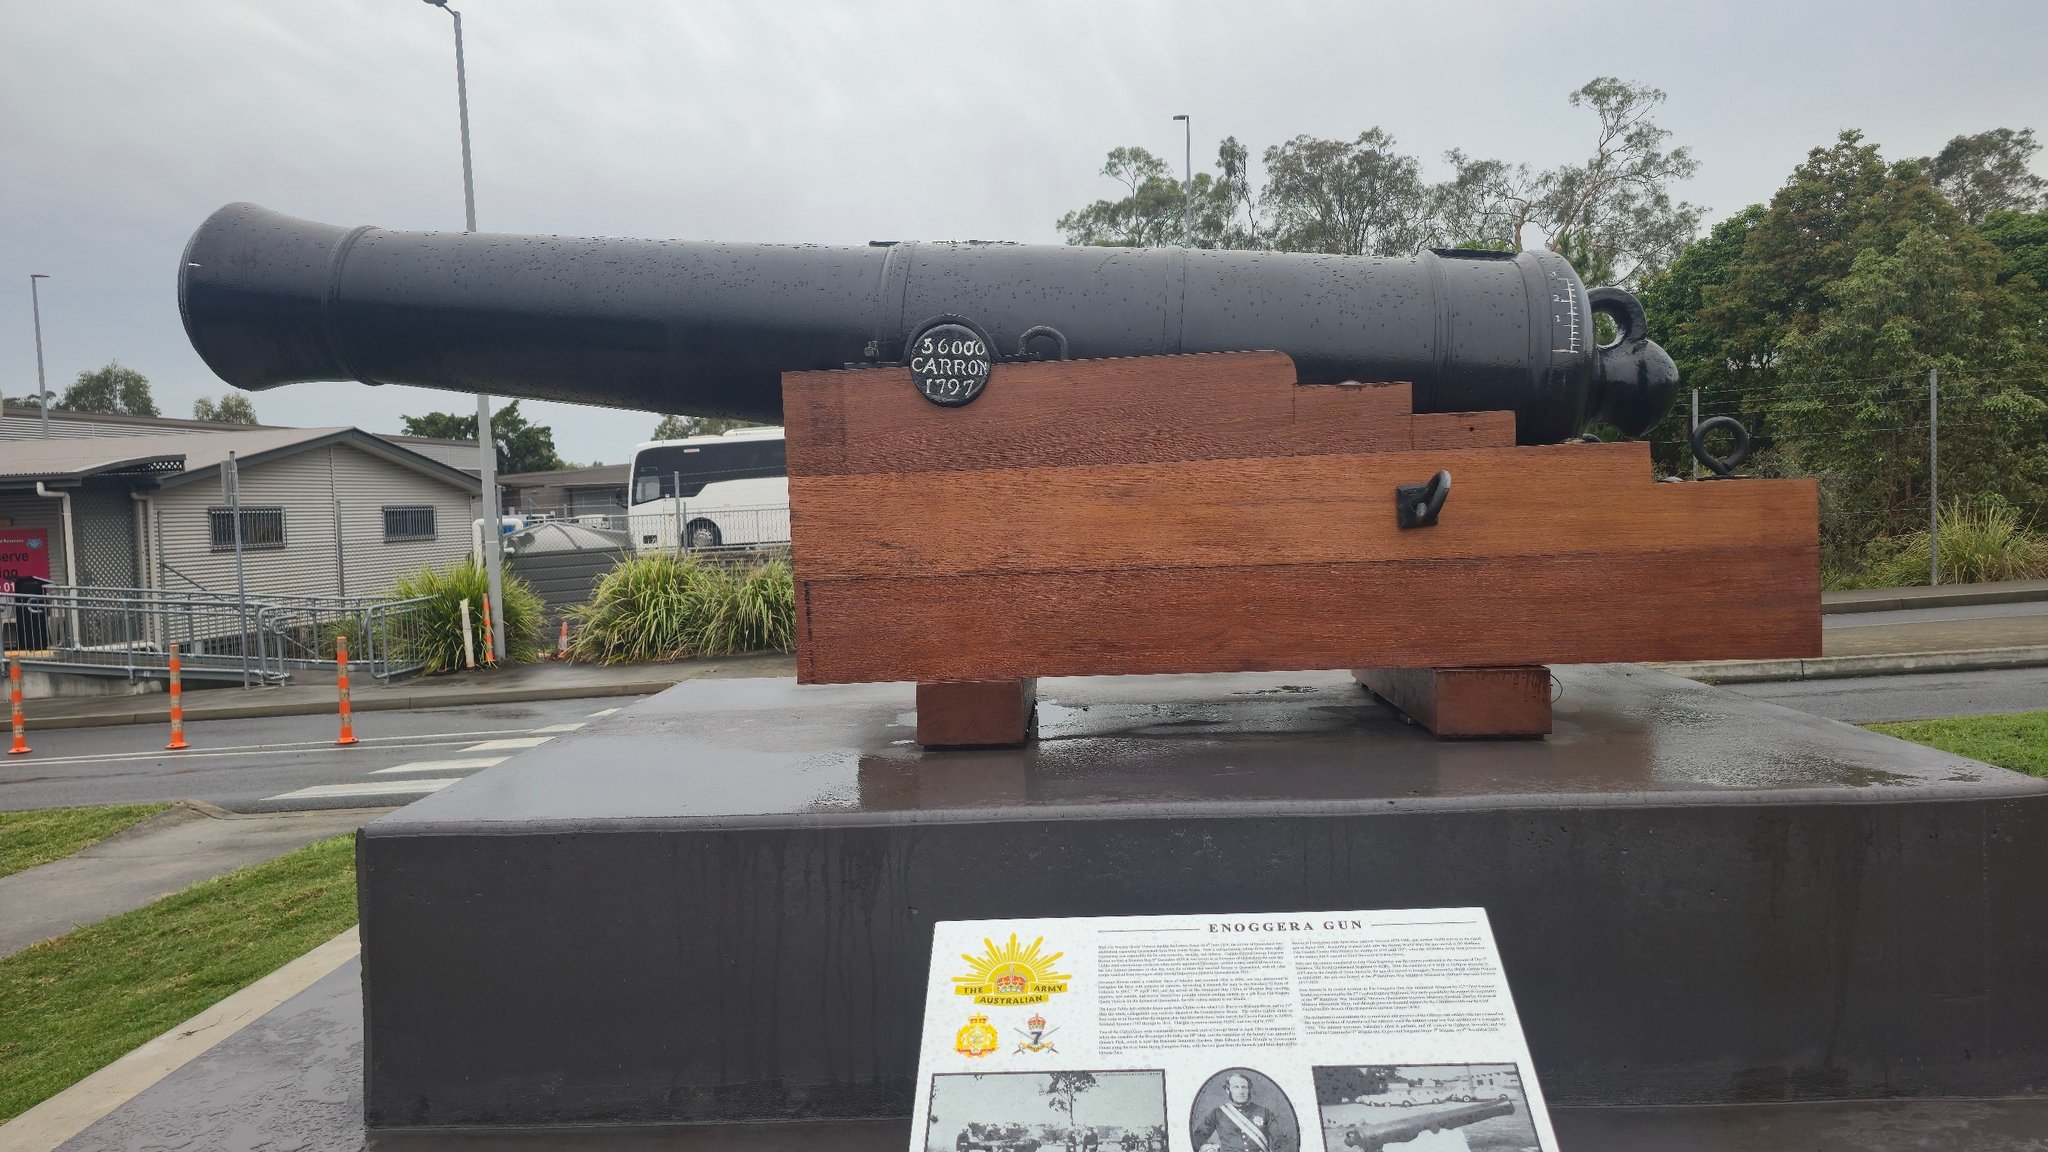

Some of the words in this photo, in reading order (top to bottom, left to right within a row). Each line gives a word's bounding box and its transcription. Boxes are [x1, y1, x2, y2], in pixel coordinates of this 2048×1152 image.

[911, 357, 988, 376] CARRON
[925, 378, 975, 396] 1797
[1208, 920, 1314, 933] ENOGGERA
[1322, 919, 1363, 930] GUN
[963, 986, 985, 994] THE
[1033, 984, 1064, 993] ARMY
[979, 995, 1043, 1005] AUSTRALIAN
[1031, 1030, 1042, 1045] 7
